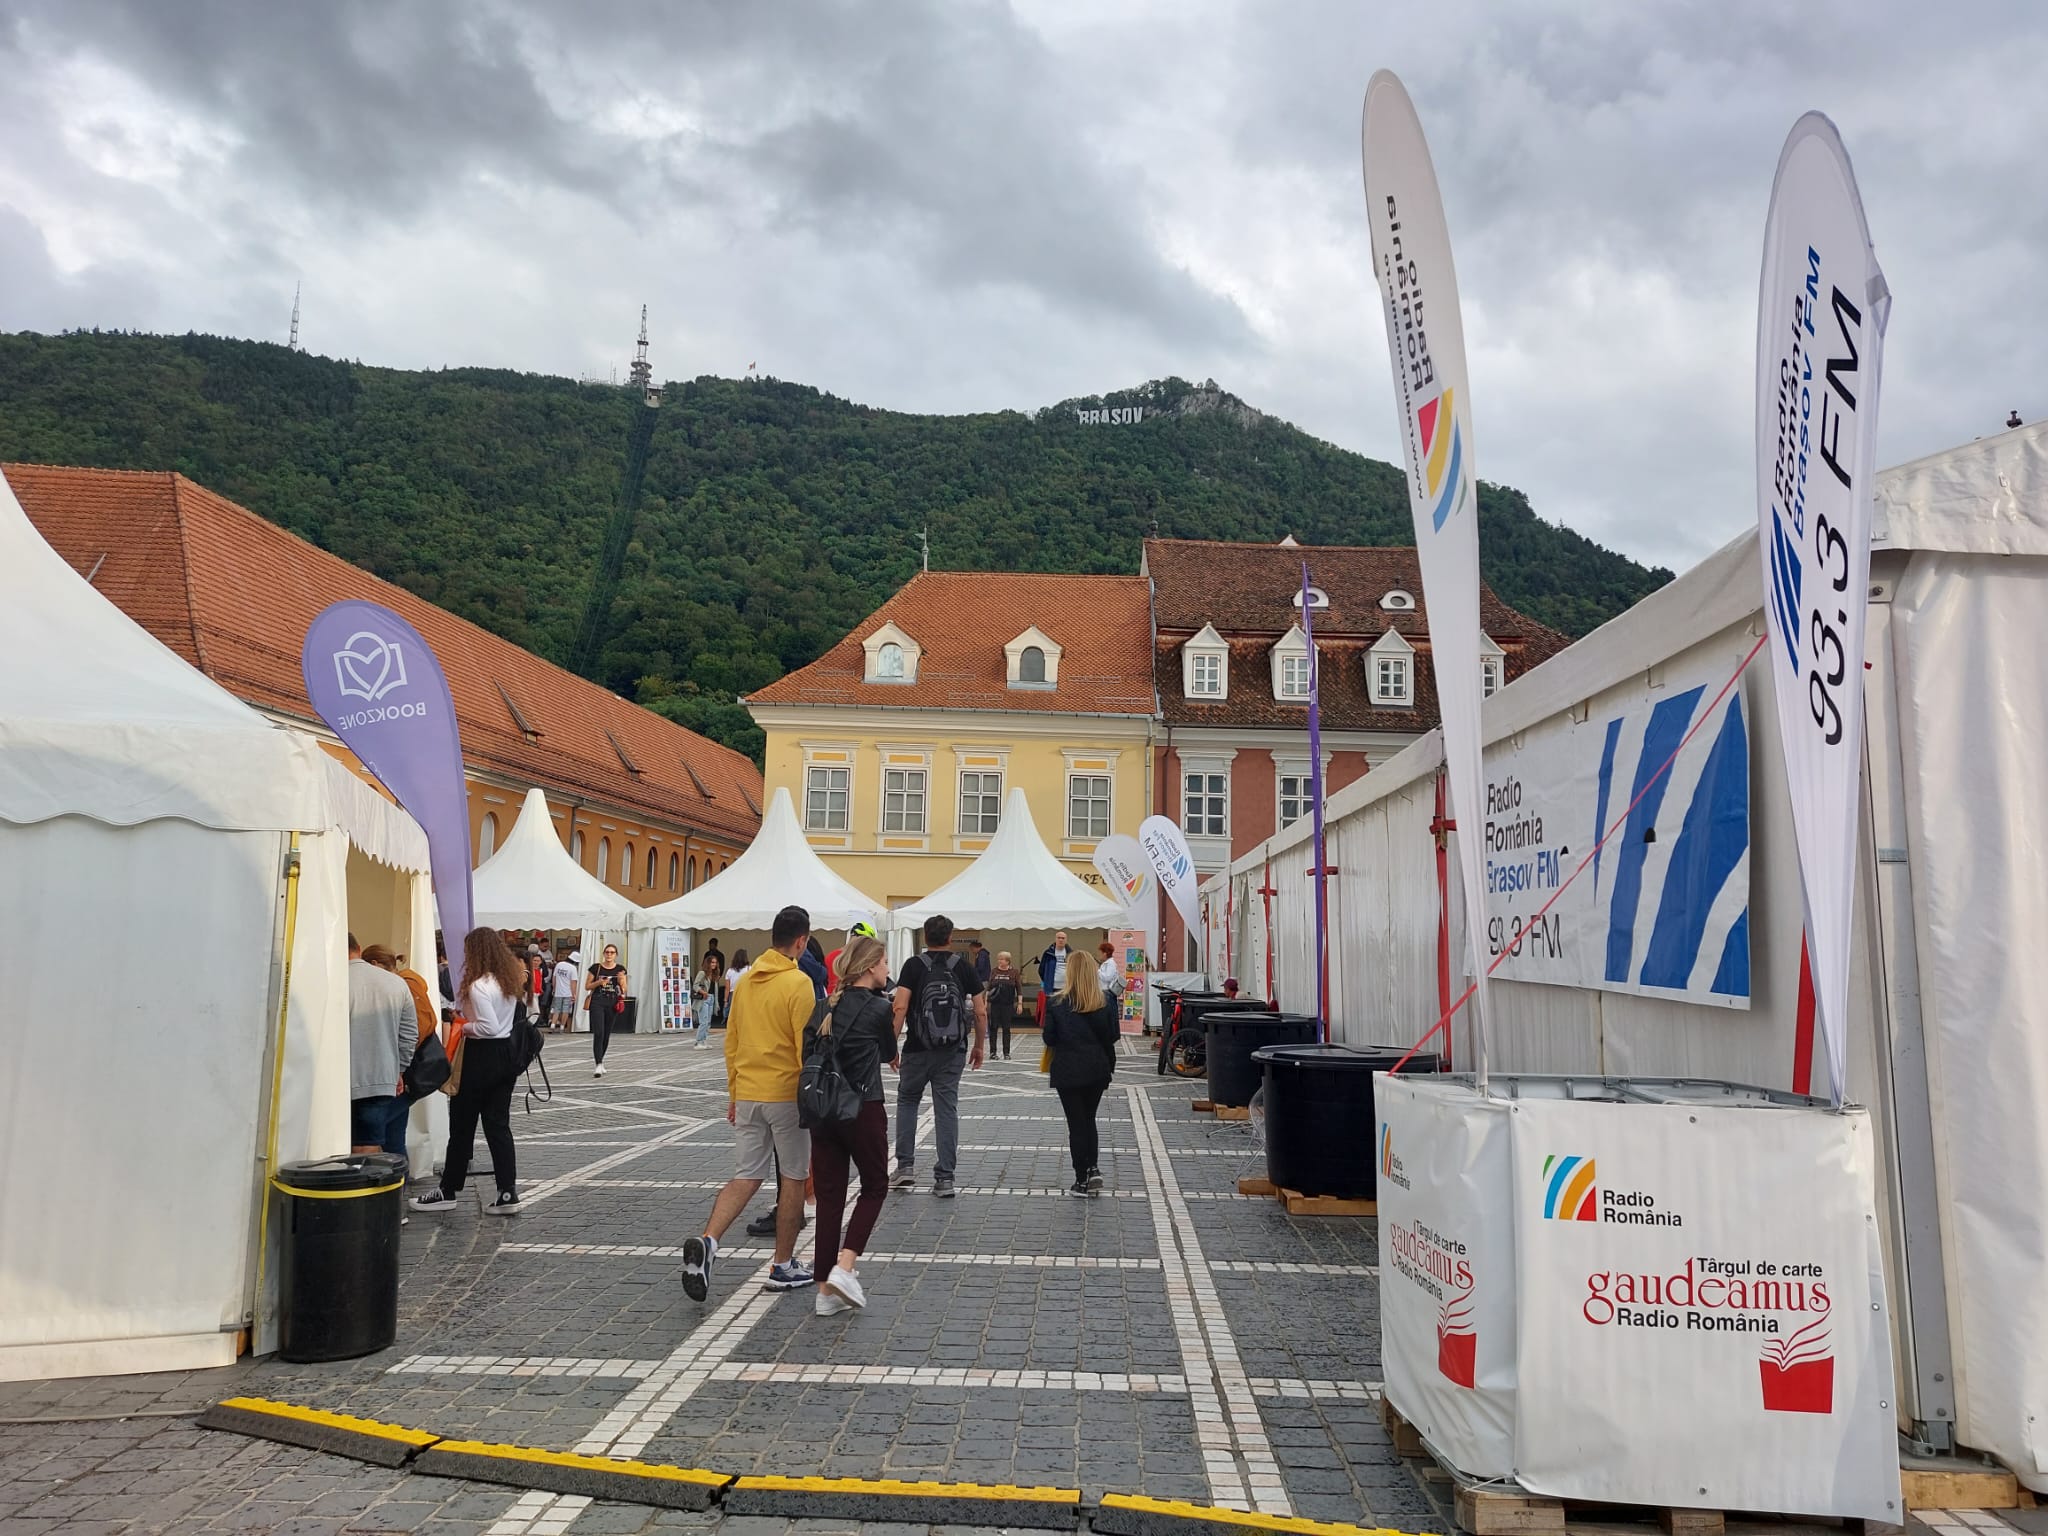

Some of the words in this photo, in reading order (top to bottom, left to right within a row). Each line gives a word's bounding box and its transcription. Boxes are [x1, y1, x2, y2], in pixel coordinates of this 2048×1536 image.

[1784, 294, 1804, 520] România
[1793, 350, 1813, 541] Brașov
[1804, 244, 1821, 337] FM
[1820, 284, 1862, 491] FM
[1775, 358, 1789, 499] Radio
[1810, 512, 1849, 746] 93.3
[1486, 775, 1522, 815] Radio
[1485, 810, 1543, 854] România
[1537, 849, 1560, 889] FM
[1530, 913, 1562, 959] FM
[1603, 1190, 1655, 1207] Radio
[1604, 1208, 1682, 1227] România
[1390, 1219, 1474, 1290] gaudeamus
[1442, 1238, 1467, 1255] carte
[1697, 1257, 1751, 1278] Târgul
[1756, 1260, 1777, 1276] de
[1782, 1263, 1823, 1277] carte
[1583, 1257, 1831, 1325] gaudeamus
[1617, 1308, 1680, 1329] Radio
[1686, 1312, 1779, 1334] România
